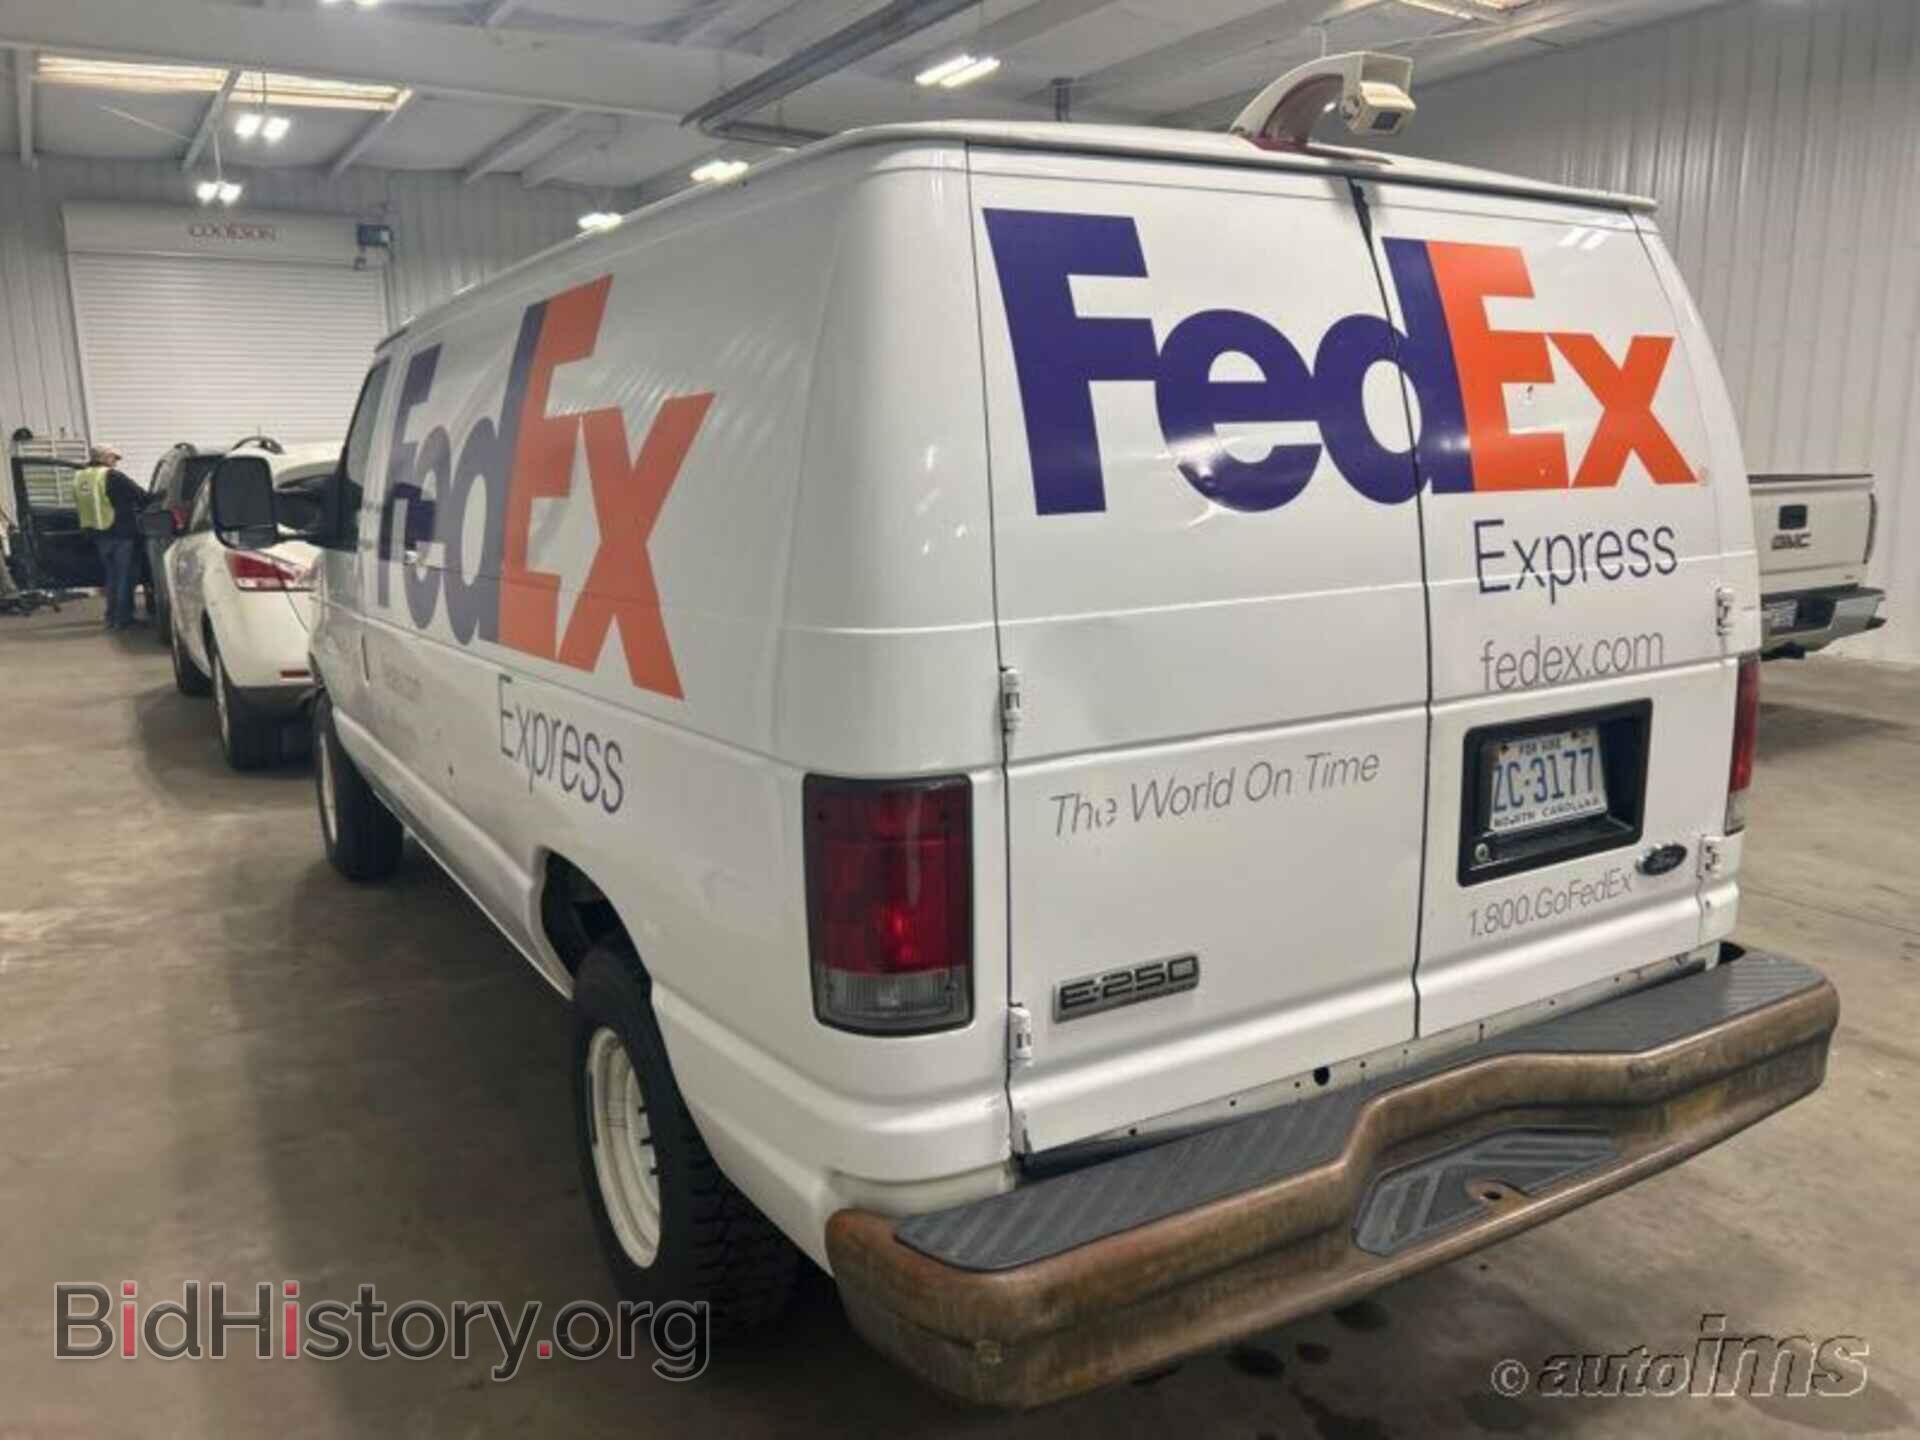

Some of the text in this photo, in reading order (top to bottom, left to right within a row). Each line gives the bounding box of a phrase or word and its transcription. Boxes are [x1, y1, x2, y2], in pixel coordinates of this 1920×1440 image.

[982, 207, 1699, 515] FedEx
[377, 274, 714, 699] FedEx
[1473, 519, 1679, 604] Express
[1480, 629, 1664, 692] fedex.com
[498, 674, 625, 815] Express
[1050, 753, 1381, 837] The World On Time
